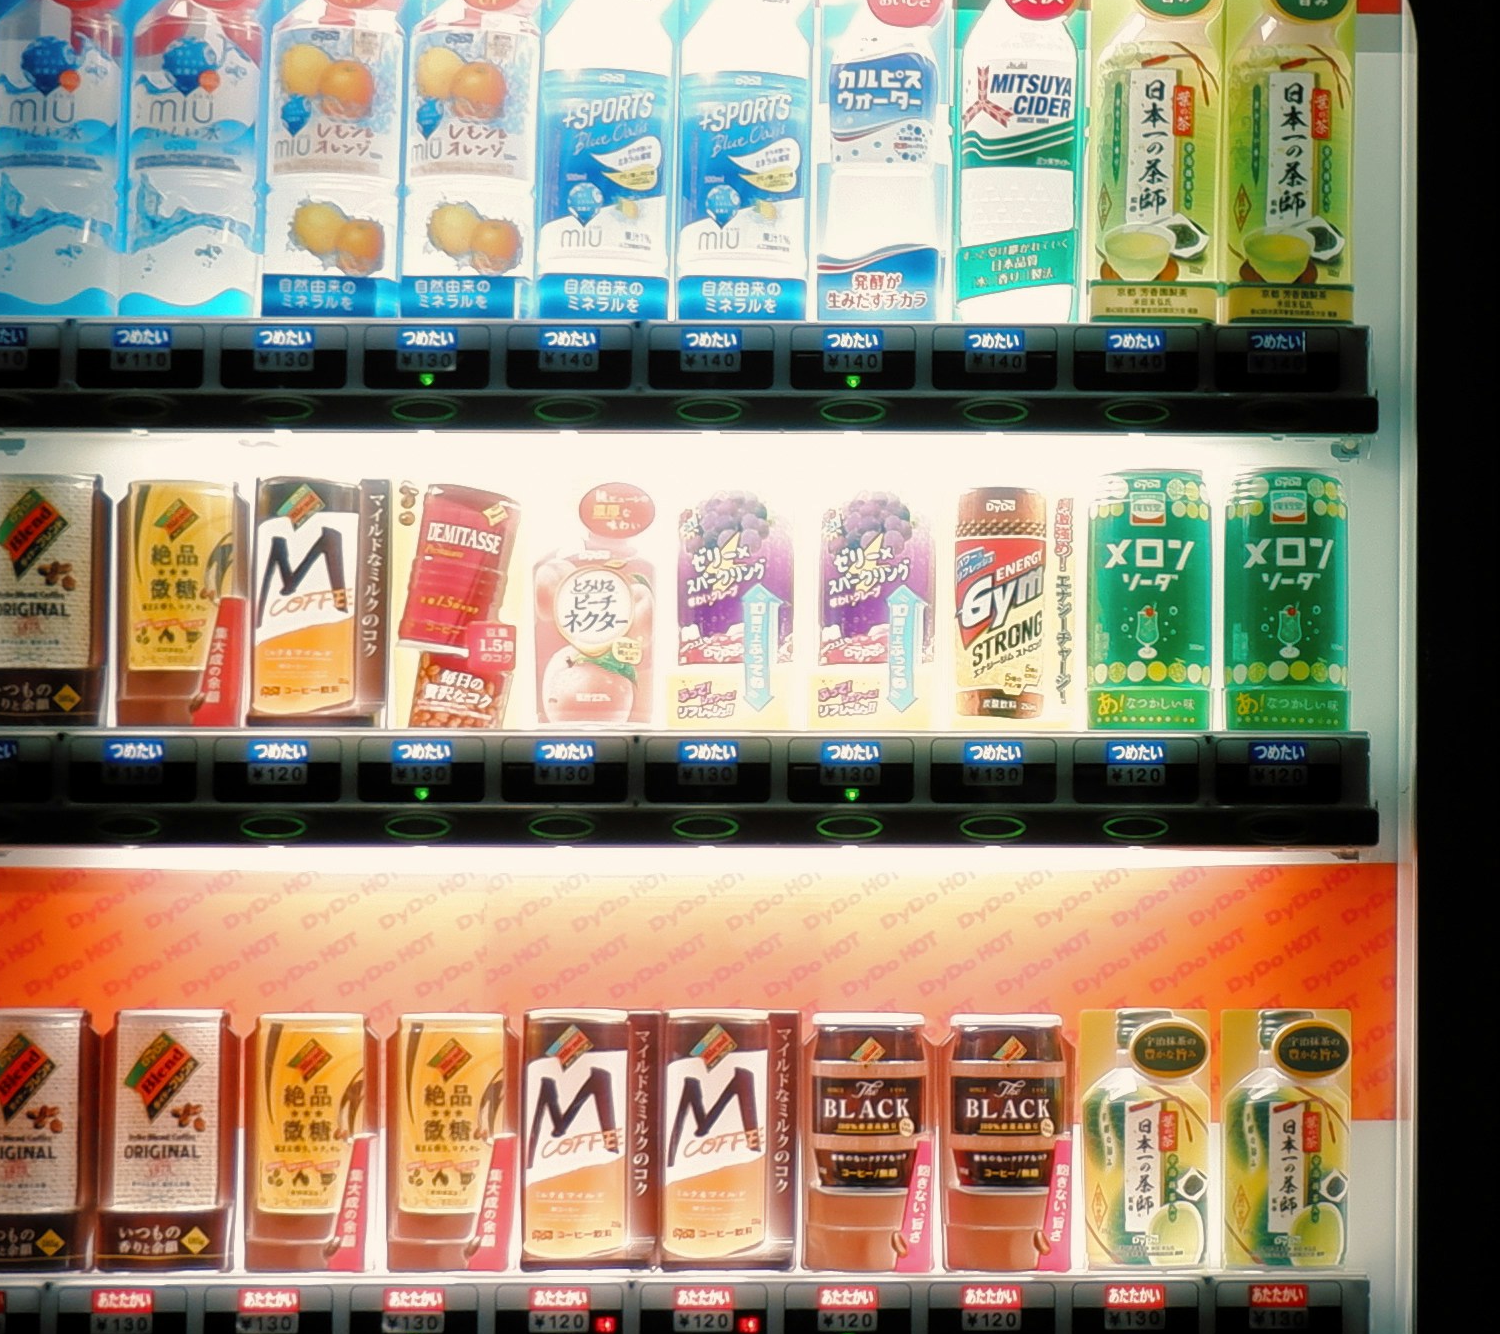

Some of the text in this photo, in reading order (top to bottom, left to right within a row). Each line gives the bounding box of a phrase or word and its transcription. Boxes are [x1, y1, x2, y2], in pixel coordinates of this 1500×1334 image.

[837, 69, 923, 90] カルピス
[990, 73, 1072, 97] MITSUYA
[837, 91, 922, 111] ウォーター
[1013, 95, 1071, 118] CIDER
[562, 92, 655, 130] +SPORTS
[699, 94, 792, 132] +SPORTS
[314, 140, 371, 156] オレンジ
[446, 141, 504, 157] オレンジ
[1138, 79, 1170, 215] 日本一の茶師
[1277, 82, 1308, 216] 日本一の茶師
[279, 278, 357, 294] 自然由来の
[415, 279, 491, 294] 自然由来の
[564, 279, 644, 296] 自然由来の
[702, 281, 781, 297] 自然由来の
[853, 273, 901, 290] 発酵が
[281, 295, 353, 311] ミネラルを
[418, 295, 488, 310] ミネラルを
[567, 298, 639, 313] ミネラルを
[705, 299, 777, 314] ミネラルを
[827, 292, 927, 309] 生みだすチカラ
[116, 329, 169, 345] つめたい
[259, 329, 312, 346] つめたい
[402, 329, 455, 346] つめたい
[544, 331, 596, 347] つめたい
[685, 331, 737, 348] つめたい
[827, 332, 879, 348] つめたい
[968, 332, 1020, 348] つめたい
[1109, 333, 1161, 349] つめたい
[1251, 334, 1301, 349] つめたい
[986, 499, 1016, 512] DyDo
[427, 522, 502, 555] DEMITASSE
[150, 545, 199, 566] 絶品
[1105, 539, 1195, 570] メロン
[1243, 538, 1333, 569] メロン
[996, 549, 1043, 581] ENERGY
[256, 526, 348, 628] M
[361, 493, 385, 657] マイルドなミルクのコク
[687, 559, 765, 594] スパークリング
[828, 559, 910, 595] スパークリング
[1122, 573, 1178, 592] ソーダ
[1262, 572, 1321, 591] ソーダ
[150, 579, 198, 600] 微糖
[573, 579, 615, 593] とろける
[269, 587, 354, 617] COFFEE
[575, 593, 616, 610] ピーチ
[961, 567, 1043, 633] Gym
[563, 611, 628, 633] ネクター
[972, 610, 1043, 668] STRONG
[441, 670, 484, 691] 毎日の
[424, 684, 492, 708] 贅沢なコク
[1127, 696, 1195, 710] なつかしい味
[1267, 696, 1338, 711] なつかしい味
[109, 743, 162, 759] つめたい
[254, 743, 307, 759] つめたい
[398, 744, 451, 760] つめたい
[541, 744, 593, 760] つめたい
[684, 744, 737, 760] つめたい
[827, 744, 879, 760] つめたい
[970, 745, 1022, 761] つめたい
[1111, 745, 1164, 761] つめたい
[1253, 745, 1306, 761] つめたい
[5, 929, 47, 961] HOT
[102, 931, 203, 997] DyDo HOT
[531, 934, 629, 999] DyDo HOT
[994, 929, 1093, 996] DyDo HOT
[1149, 928, 1246, 995] DyDo HOT
[1143, 1035, 1197, 1047] 宇治抹茶の
[1288, 1036, 1340, 1047] 宇治抹茶の
[1144, 1048, 1197, 1061] 豊かな旨み
[1288, 1048, 1340, 1061] 豊かな旨み
[284, 1085, 332, 1107] 絶品
[424, 1084, 472, 1107] 絶品
[852, 1080, 884, 1099] The
[994, 1079, 1026, 1099] The
[632, 1030, 650, 1196] マイルドなミルクのコク
[667, 1066, 761, 1167] M
[775, 1028, 792, 1193] マイルドなミルクのコク
[824, 1098, 910, 1119] BLACK
[966, 1098, 1051, 1119] BLACK
[526, 1067, 619, 1169] M
[283, 1120, 331, 1141] 微糖
[424, 1120, 471, 1141] 微糖
[124, 1145, 202, 1159] ORIGINAL
[541, 1128, 624, 1159] COFFEE
[684, 1127, 765, 1159] COFFEE
[1135, 1119, 1155, 1215] 日本一の茶師
[1279, 1119, 1299, 1215] 日本一の茶師
[119, 1226, 181, 1239] いつもの
[97, 1292, 152, 1309] あたたかい
[243, 1291, 298, 1308] あたたかい
[389, 1290, 443, 1307] あたたかい
[533, 1289, 587, 1307] あたたかい
[677, 1289, 730, 1306] あたたかい
[820, 1288, 874, 1305] あたたかい
[964, 1287, 1018, 1305] あたたかい
[1108, 1287, 1161, 1304] あたたかい
[1251, 1286, 1304, 1303] あたたかい
